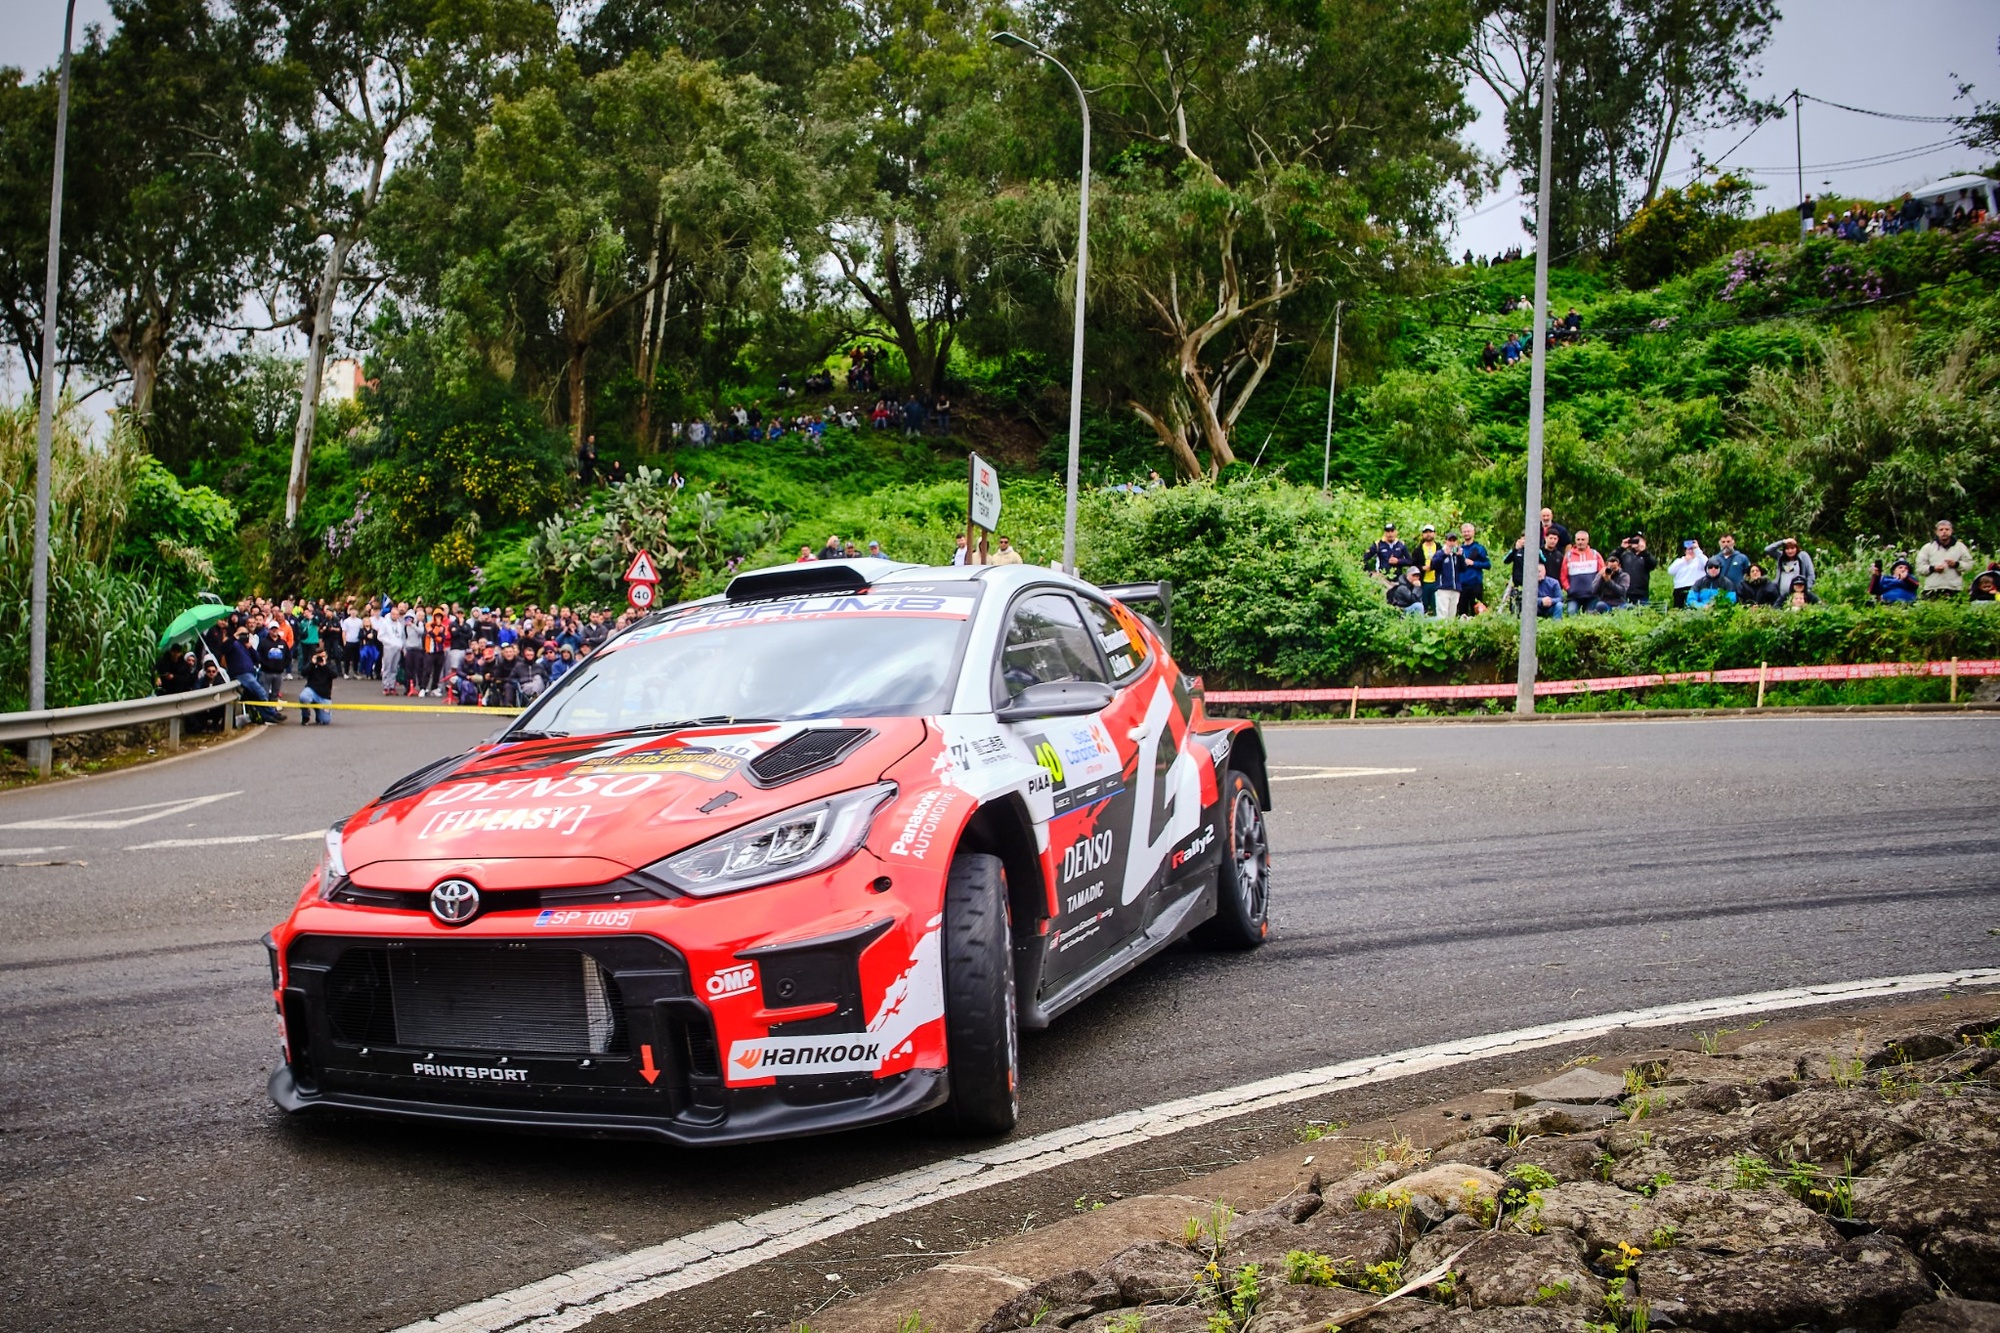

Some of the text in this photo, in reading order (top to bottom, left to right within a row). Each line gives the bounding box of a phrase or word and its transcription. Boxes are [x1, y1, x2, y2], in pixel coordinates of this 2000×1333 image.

[634, 591, 650, 601] 40
[857, 585, 936, 596] Racing
[669, 596, 947, 633] FORUM8
[720, 745, 750, 757] 40
[1034, 742, 1064, 784] 40
[426, 774, 661, 807] DENSO
[1028, 775, 1050, 795] PIAA
[889, 790, 942, 857] Panasonic
[912, 792, 957, 860] AUTOMOTIVE
[1063, 829, 1113, 884] DENSO
[1172, 824, 1214, 869] Rally2
[1066, 880, 1104, 914] TAMADIC
[550, 911, 582, 925] SP
[586, 911, 631, 926] 1005
[706, 967, 755, 994] OMP
[412, 1062, 529, 1081] PRINTSPORT
